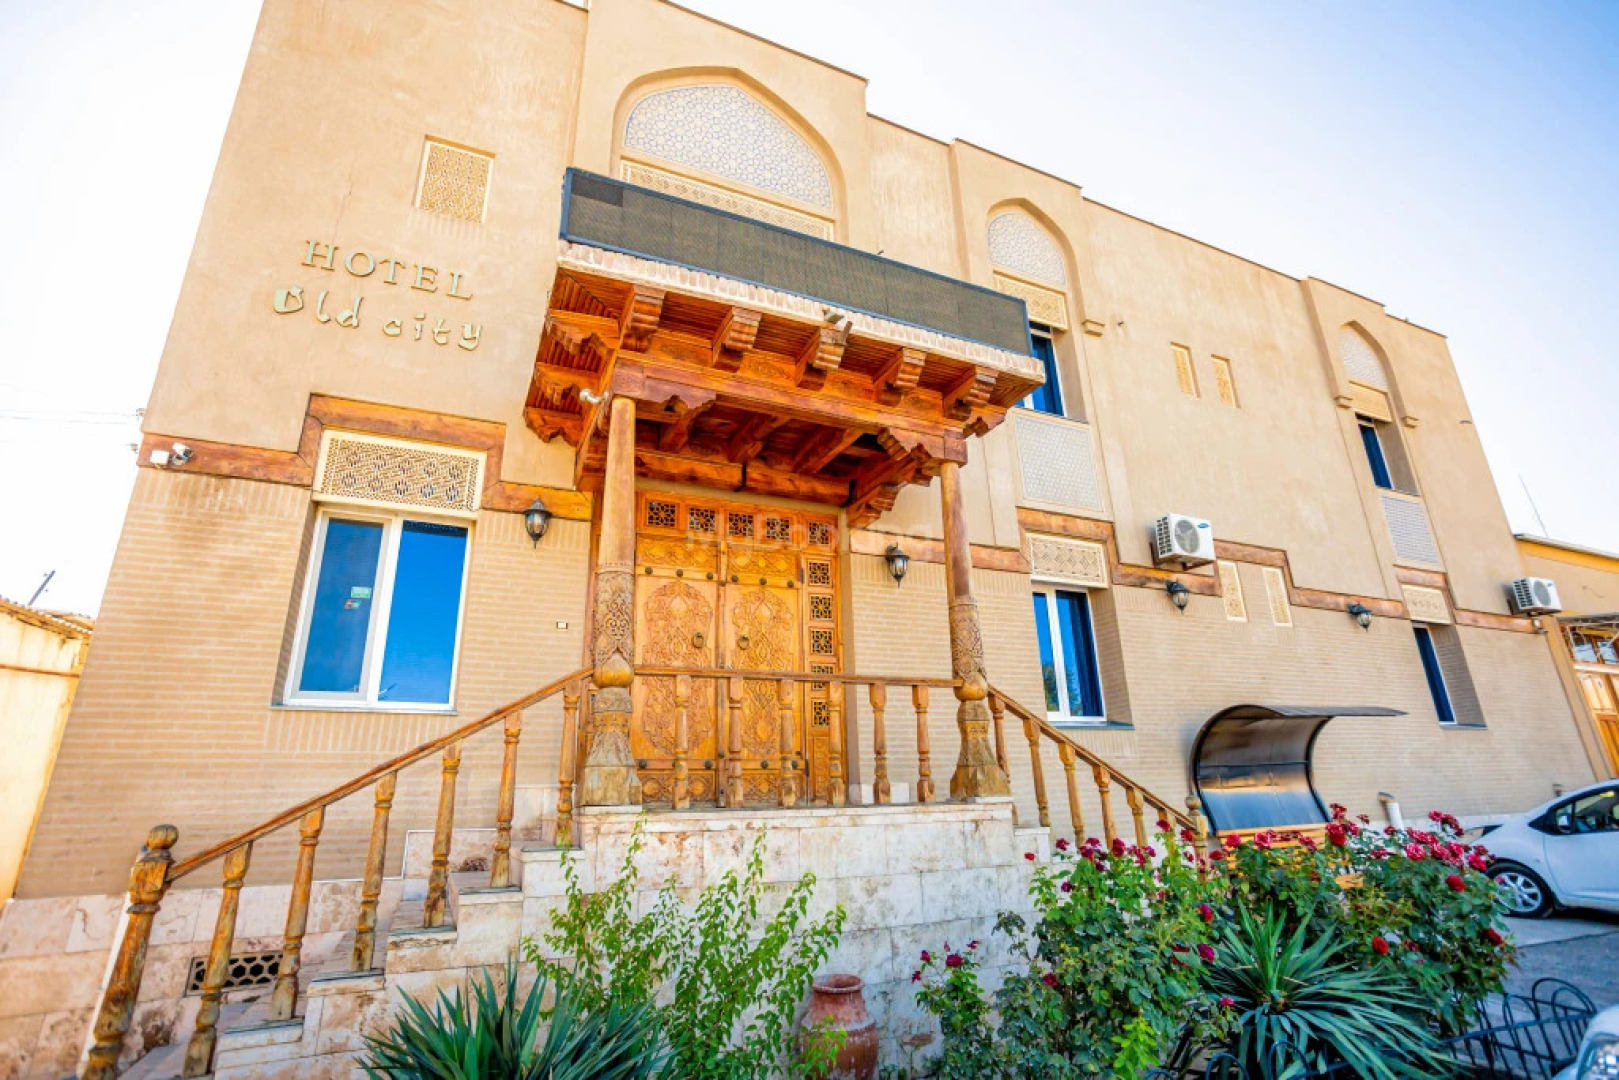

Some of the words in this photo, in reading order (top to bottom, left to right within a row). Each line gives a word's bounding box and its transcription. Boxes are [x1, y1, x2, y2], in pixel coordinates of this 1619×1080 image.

[301, 239, 474, 301] HOTEL
[273, 285, 364, 329] Old
[382, 312, 482, 351] city
